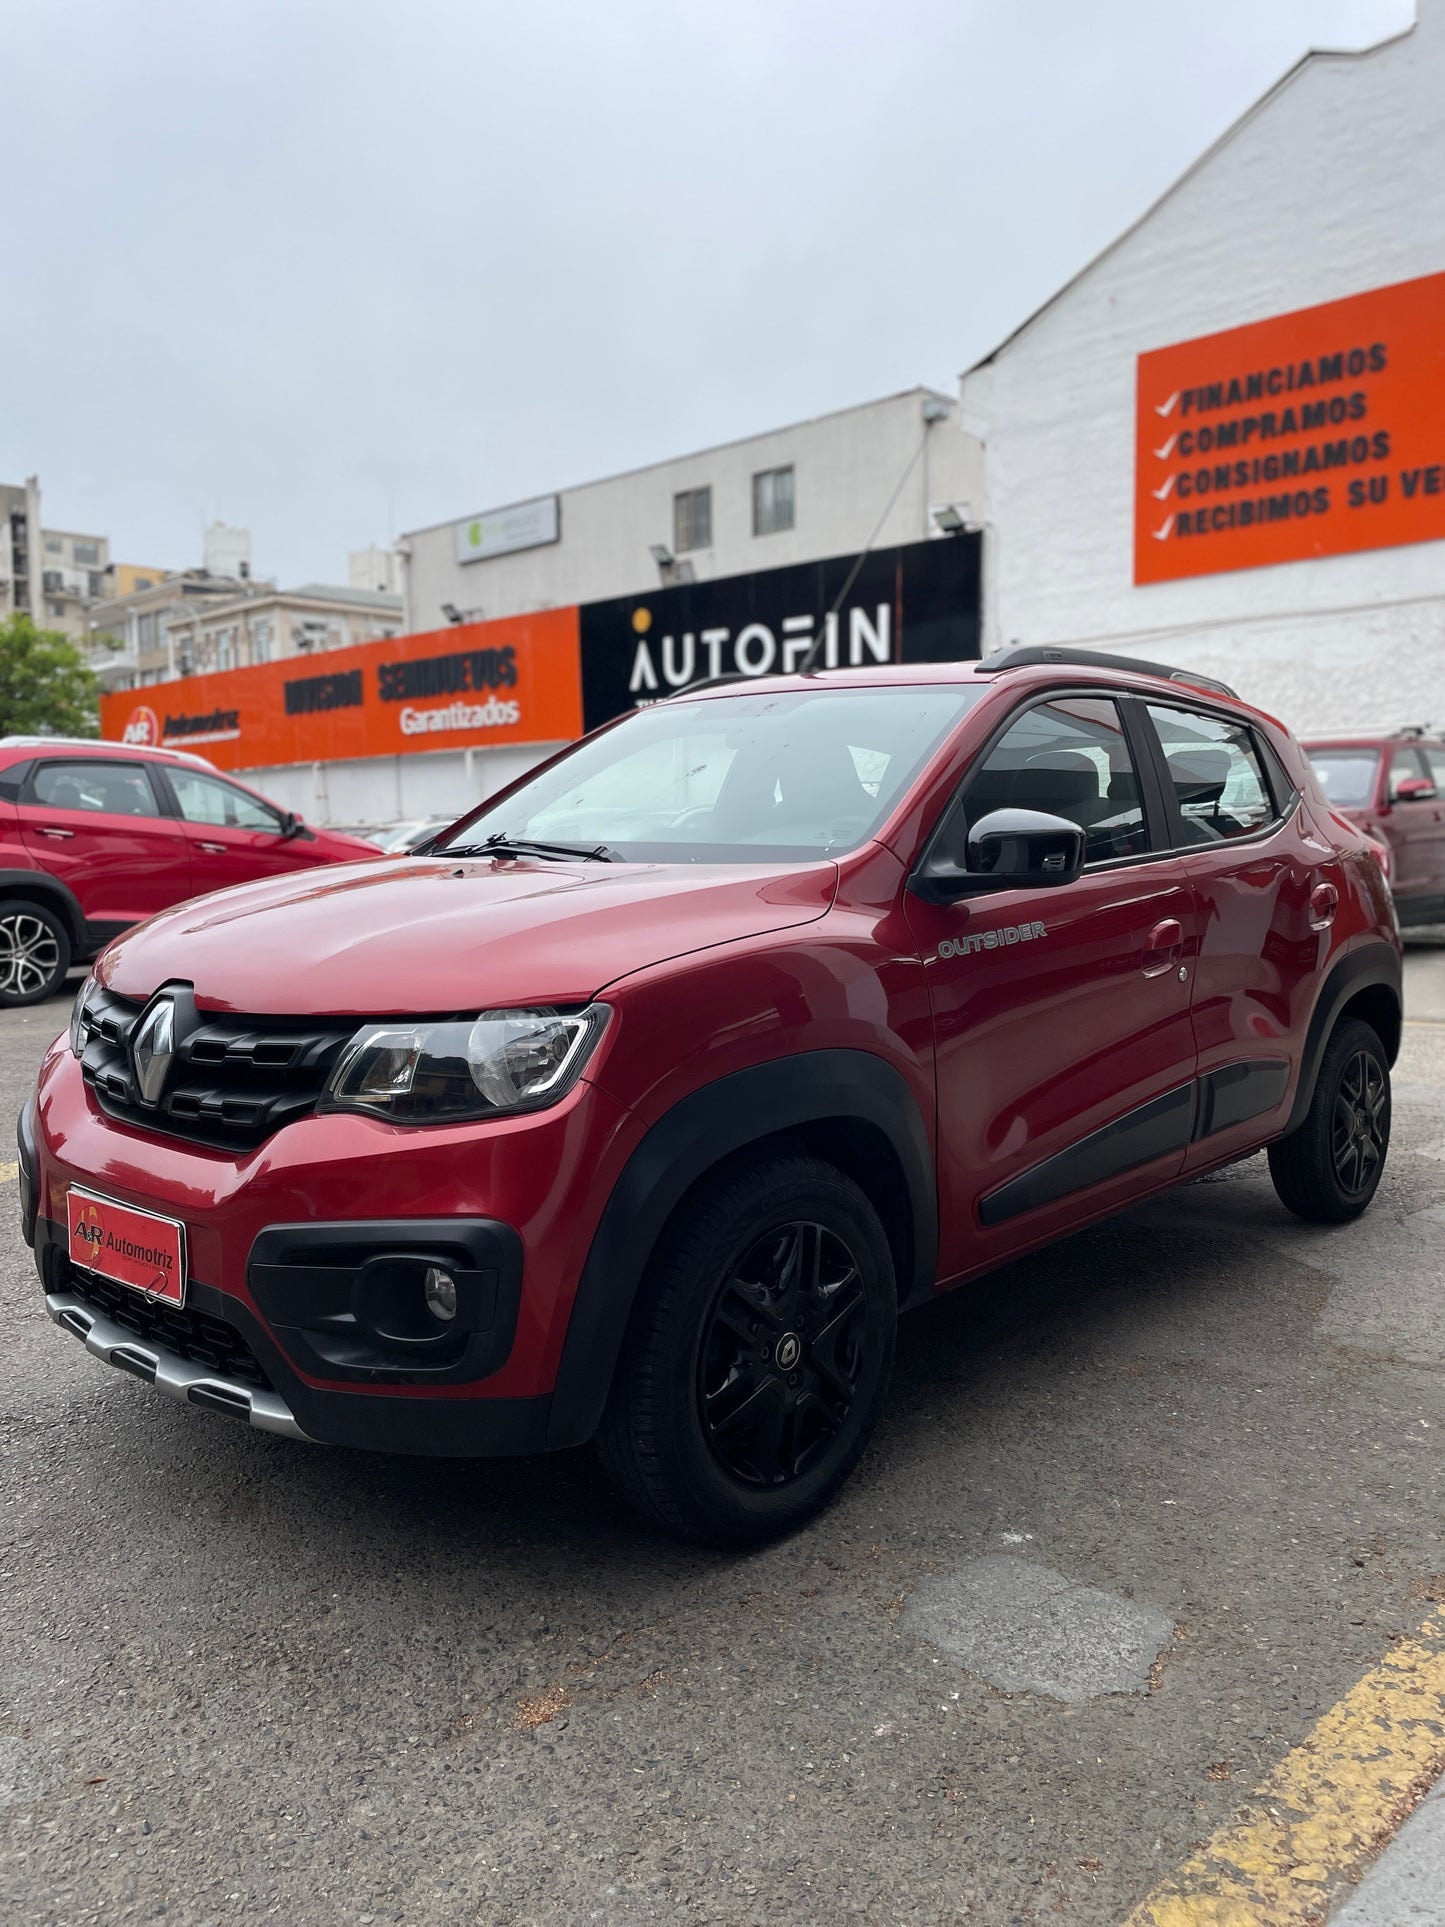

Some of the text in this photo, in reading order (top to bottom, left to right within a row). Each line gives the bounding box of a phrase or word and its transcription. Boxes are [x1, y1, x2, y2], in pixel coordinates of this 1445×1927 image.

[1181, 343, 1386, 416] FINANCIAMOS
[1178, 392, 1367, 457] COMPRAMOS
[1177, 431, 1390, 498] CONSIGNAMOS
[1176, 486, 1330, 538] RECIBIMOS
[1347, 475, 1388, 508] SU
[629, 603, 892, 692] AUTOFIN
[400, 695, 520, 735] Garantizados
[938, 921, 1048, 959] OUTSIDER
[105, 1231, 173, 1270] Automotriz
